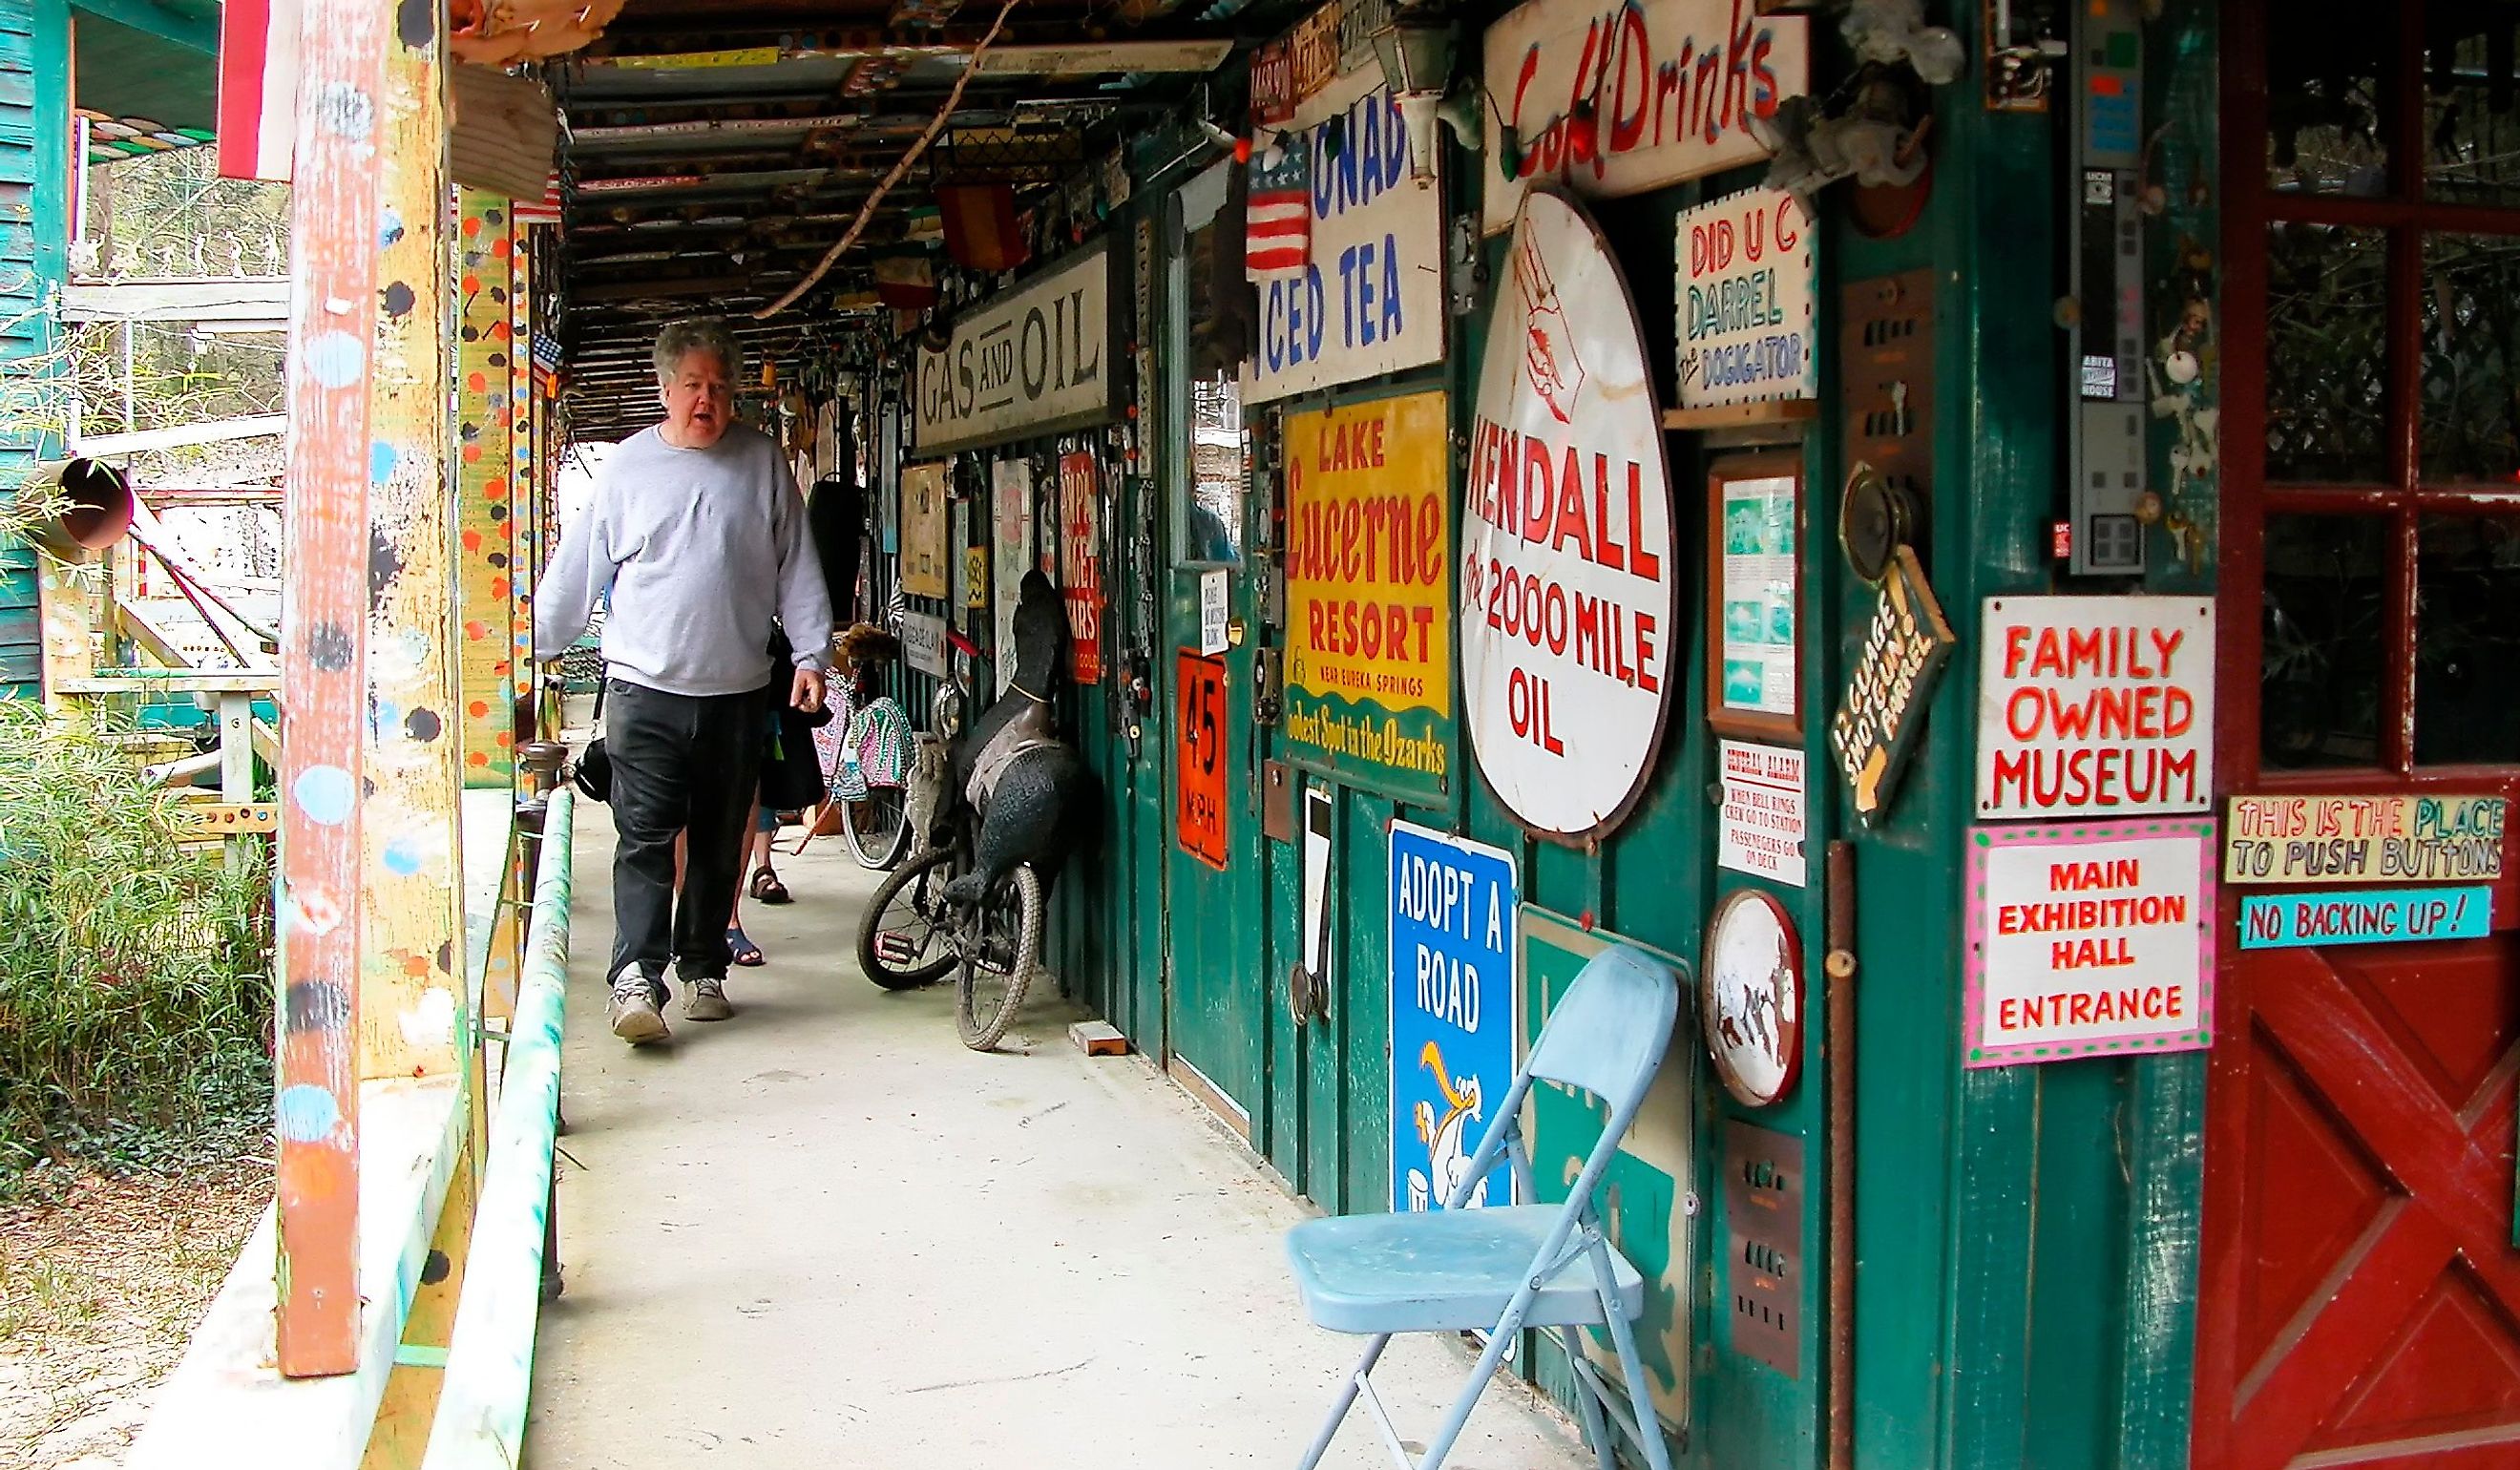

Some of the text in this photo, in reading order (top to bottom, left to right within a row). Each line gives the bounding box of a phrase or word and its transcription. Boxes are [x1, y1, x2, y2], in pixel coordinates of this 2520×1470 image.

[1610, 0, 1778, 152] Drinks
[1304, 91, 1413, 220] ONAD
[1691, 216, 1735, 278] DID
[1744, 208, 1764, 262] U
[1338, 233, 1403, 348] TEA
[1687, 266, 1784, 341] DARREL
[922, 287, 1101, 427] GAS AND OIL
[1318, 418, 1384, 473] LAKE
[1286, 456, 1442, 586] Lucerne
[1468, 413, 1661, 583] KENDALL
[1308, 598, 1435, 663] RESORT
[1486, 556, 1568, 657] 2000
[1574, 589, 1659, 695] MILE
[1848, 588, 1896, 716] GUAGE
[2004, 625, 2185, 680] FAMILY
[1319, 665, 1424, 698] NEAR EUREKA SPRINGS
[1508, 666, 1565, 759] OIL
[1880, 629, 1938, 743] BARREL
[1186, 674, 1217, 776] 45
[2006, 684, 2194, 743] OWNED
[1383, 717, 1446, 776] Ozarks
[1991, 746, 2198, 809] MUSEUM
[1725, 804, 1803, 834] CREW GO TO STATION
[1731, 788, 1796, 815] WHEN BELL RINGS
[2237, 796, 2506, 839] THIS IS THE PLACE
[1746, 850, 1778, 871] ON DECK
[1783, 840, 1796, 857] GO
[2048, 858, 2141, 893] MAIN
[2232, 839, 2275, 877] TO
[2283, 837, 2369, 877] PUSH
[1397, 850, 1503, 954] ADOPT A
[1998, 893, 2187, 936] EXHIBITION
[2248, 902, 2282, 941] NO
[2295, 900, 2399, 939] BACKING
[2050, 935, 2137, 971] HALL
[1416, 940, 1480, 1035] ROAD
[1999, 984, 2184, 1032] ENTRANCE
